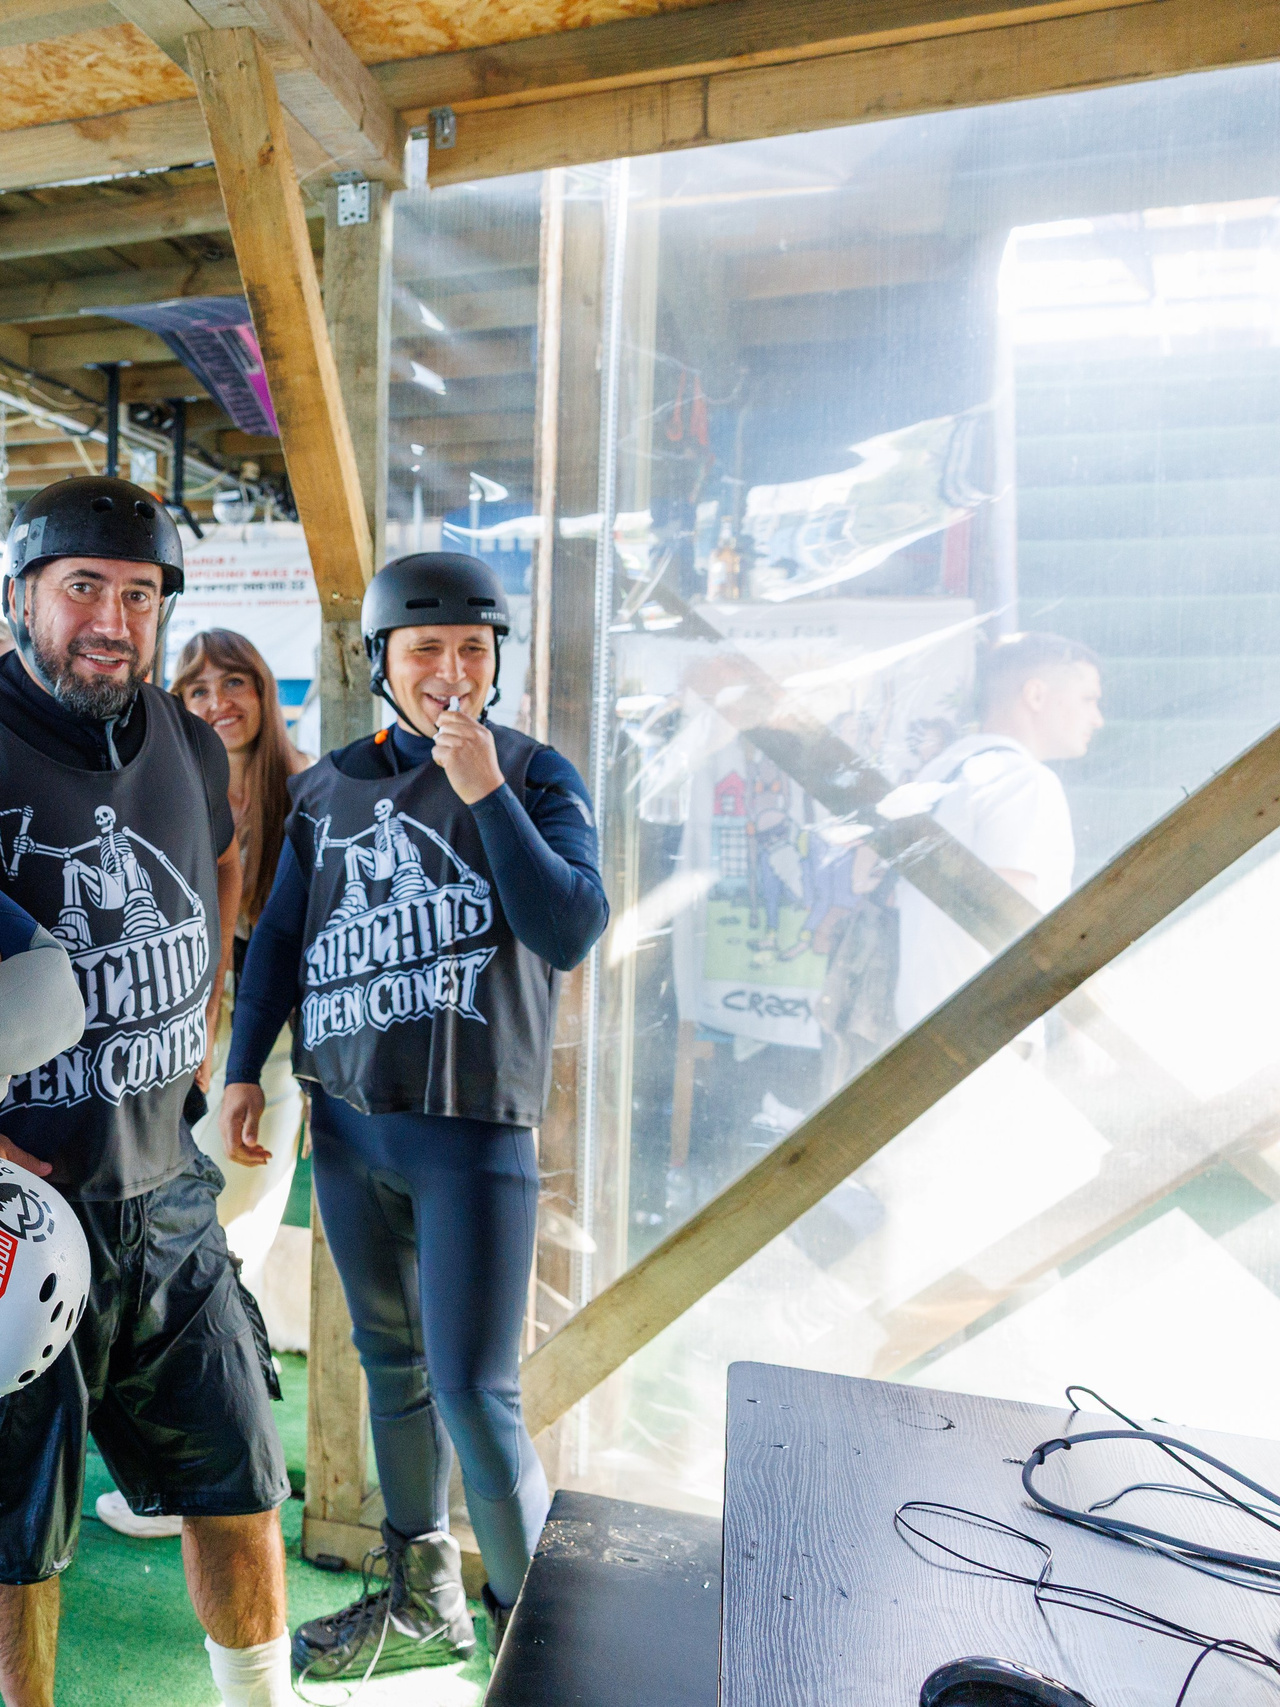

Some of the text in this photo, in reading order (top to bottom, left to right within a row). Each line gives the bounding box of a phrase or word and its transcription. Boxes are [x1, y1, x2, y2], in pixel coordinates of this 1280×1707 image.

[2, 1005, 209, 1109] PEN CONTES
[304, 986, 364, 1049] OPEN
